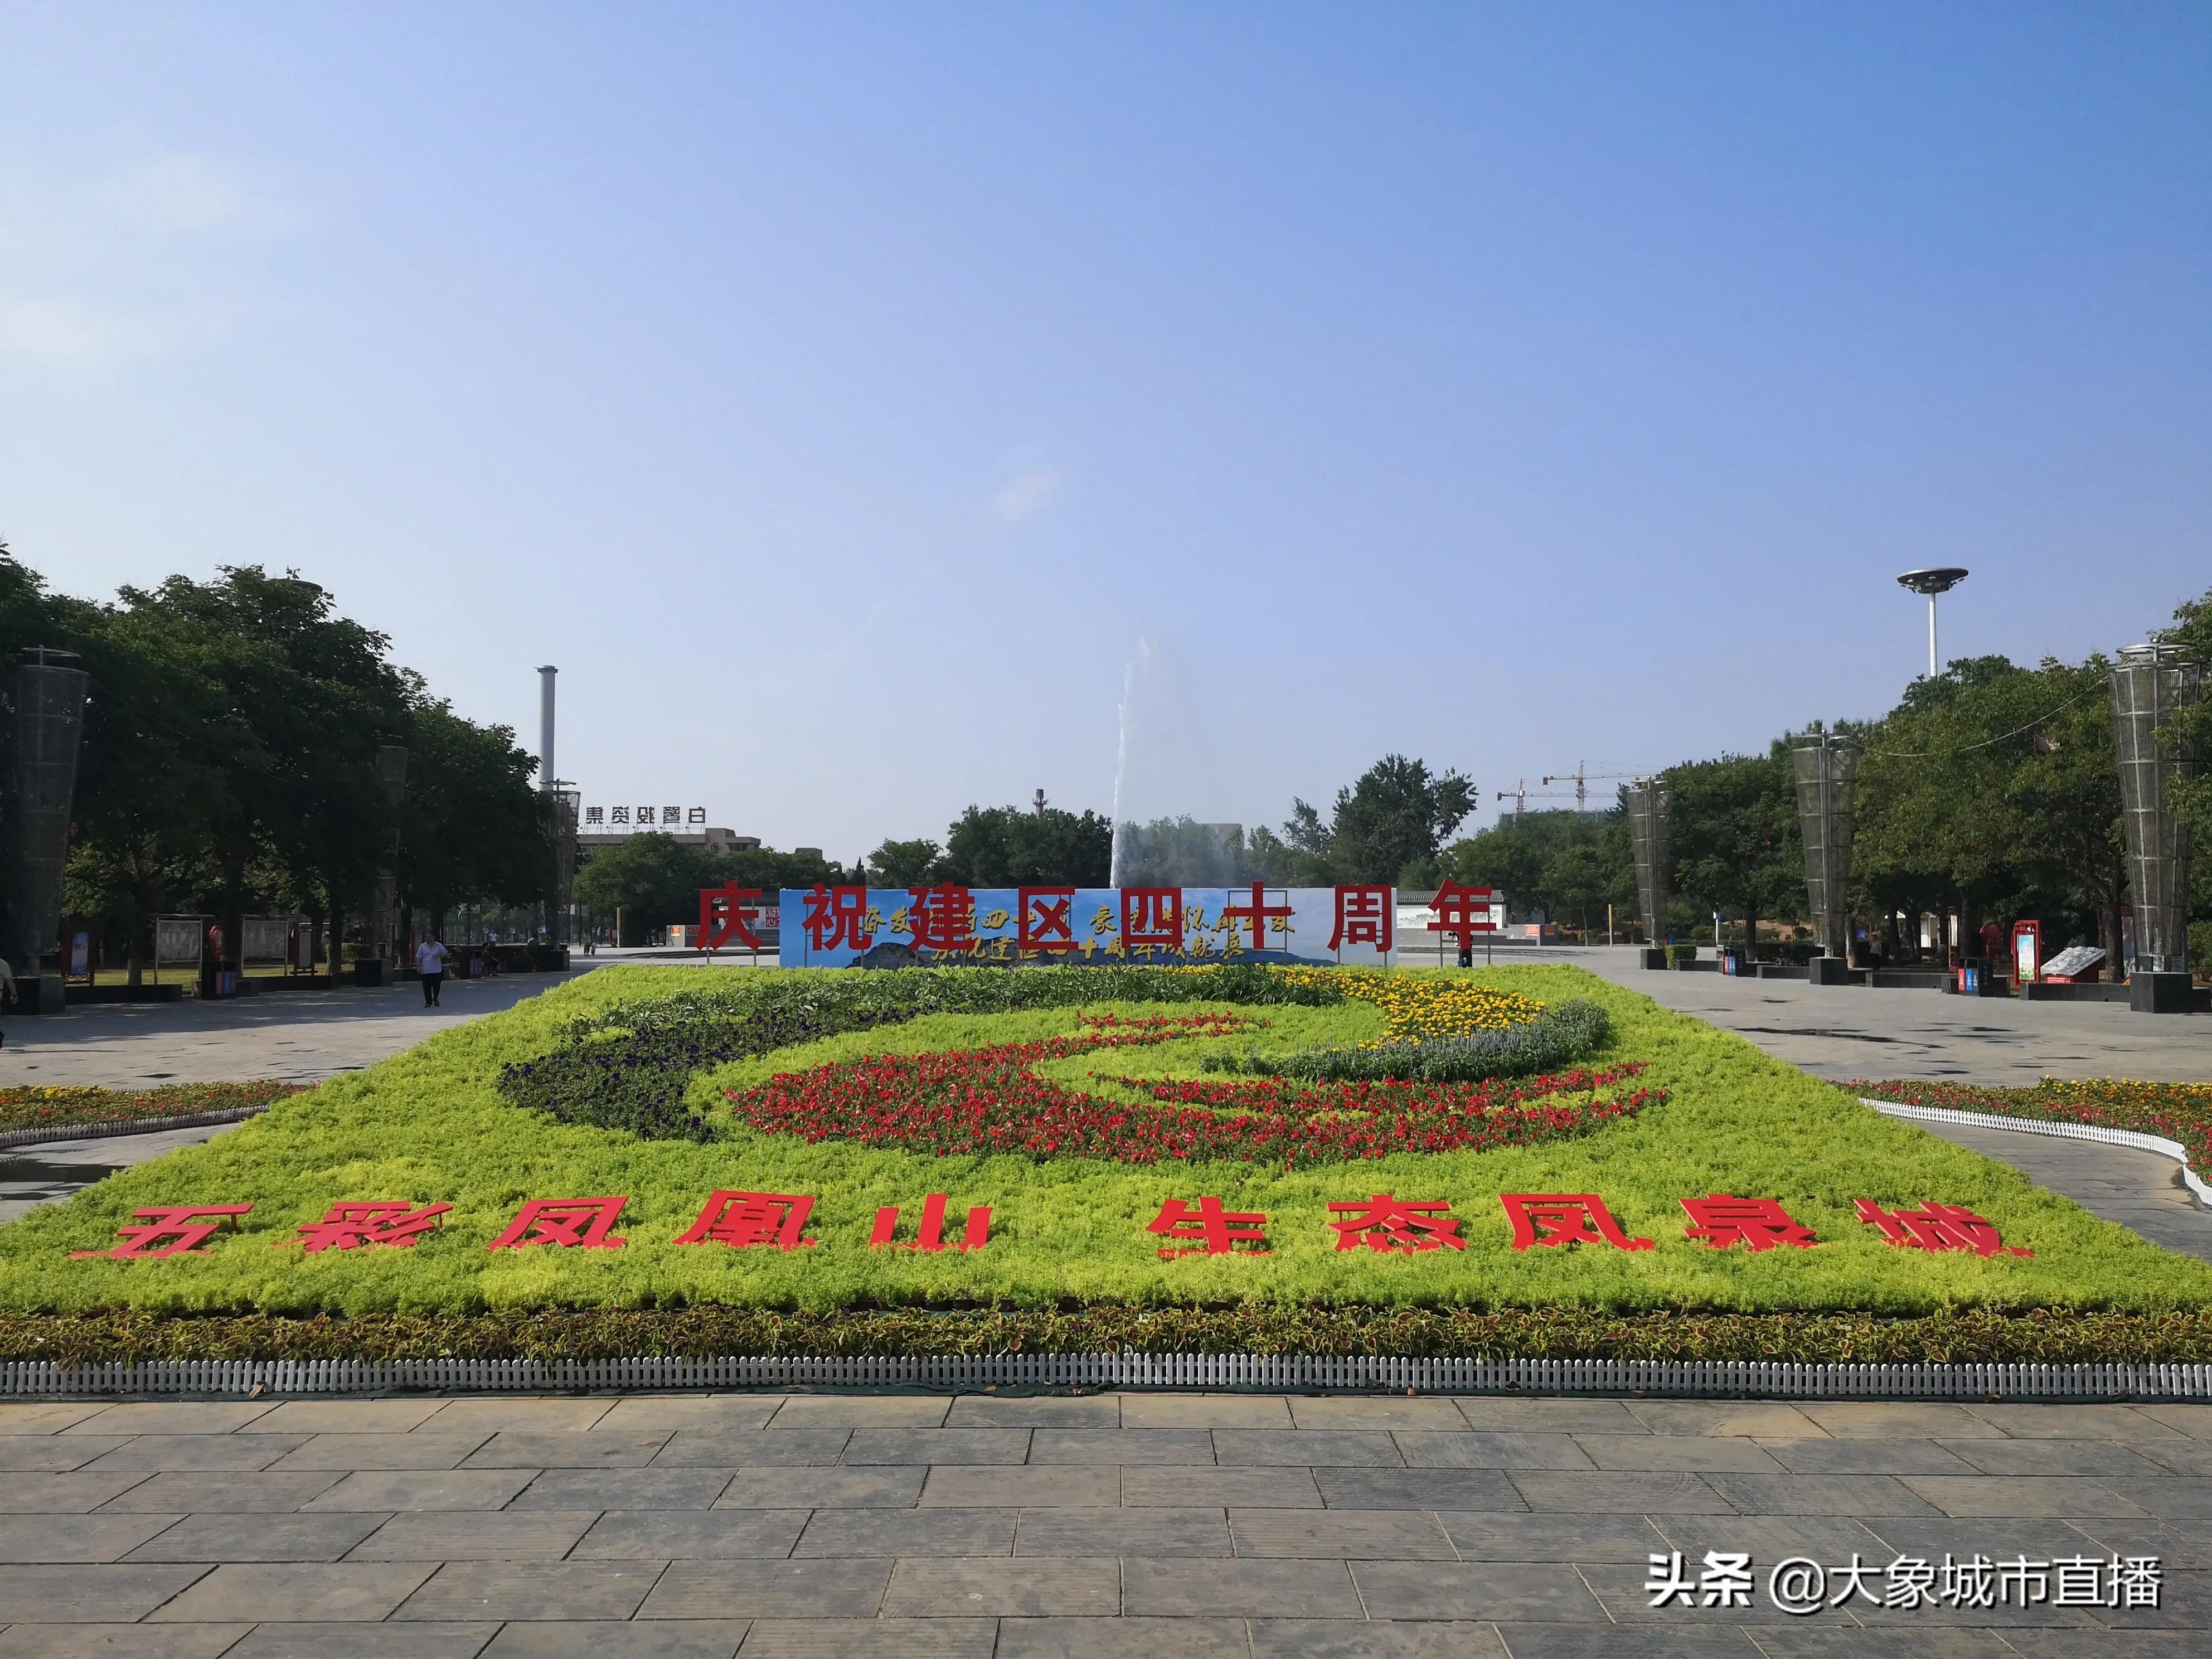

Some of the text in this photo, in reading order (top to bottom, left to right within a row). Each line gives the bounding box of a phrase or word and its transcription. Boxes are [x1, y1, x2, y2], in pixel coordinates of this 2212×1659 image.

[693, 879, 1497, 952] 庆祝建区四十周年
[70, 1190, 2035, 1260] 五彩凤凰山 生态凤泉城
